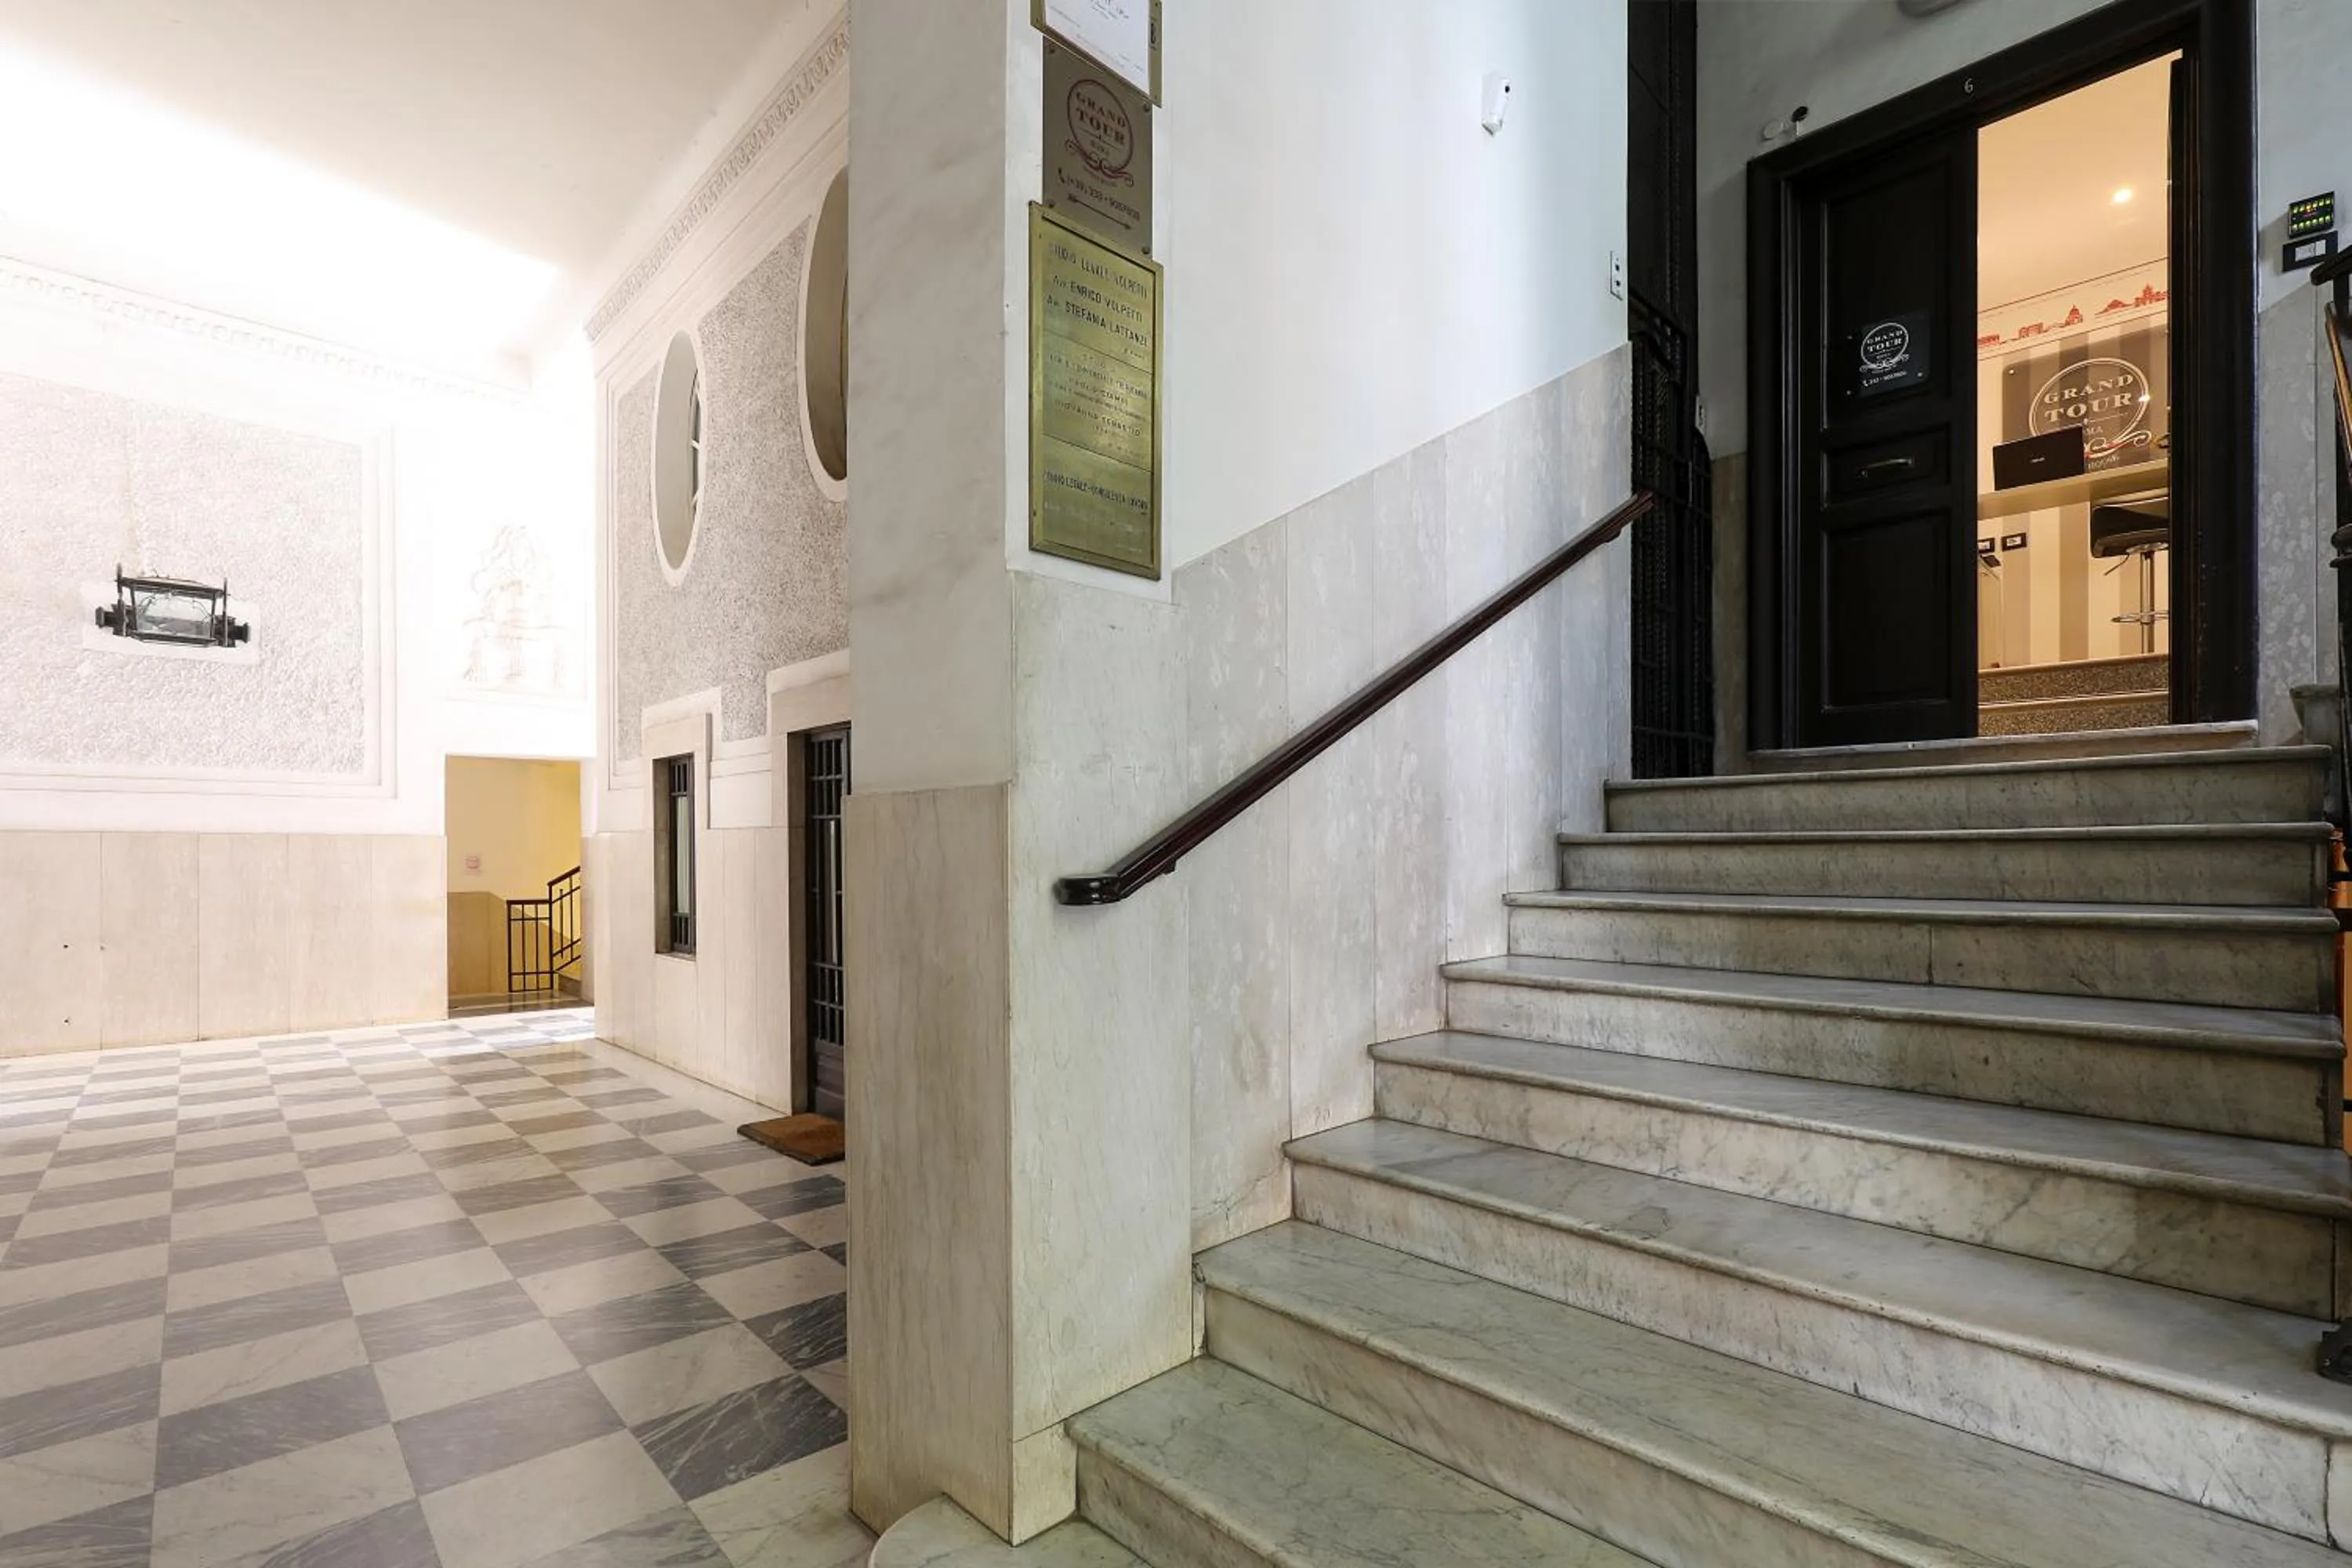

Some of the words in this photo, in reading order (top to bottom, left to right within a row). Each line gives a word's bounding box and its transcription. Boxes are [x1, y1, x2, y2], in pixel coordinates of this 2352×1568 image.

[1964, 78, 1973, 94] 6
[1076, 92, 1126, 128] GRAND
[1076, 107, 1125, 145] TOUR
[1070, 281, 1102, 303] ENRICO
[1105, 297, 1142, 322] VOLPETTI
[1065, 301, 1106, 329] STEFANIA
[1109, 323, 1148, 347] LATTANZI
[1867, 330, 1903, 344] GRAND
[1867, 338, 1902, 352] TOUR
[2044, 374, 2134, 405] GRAND
[2044, 393, 2132, 423] TOUR
